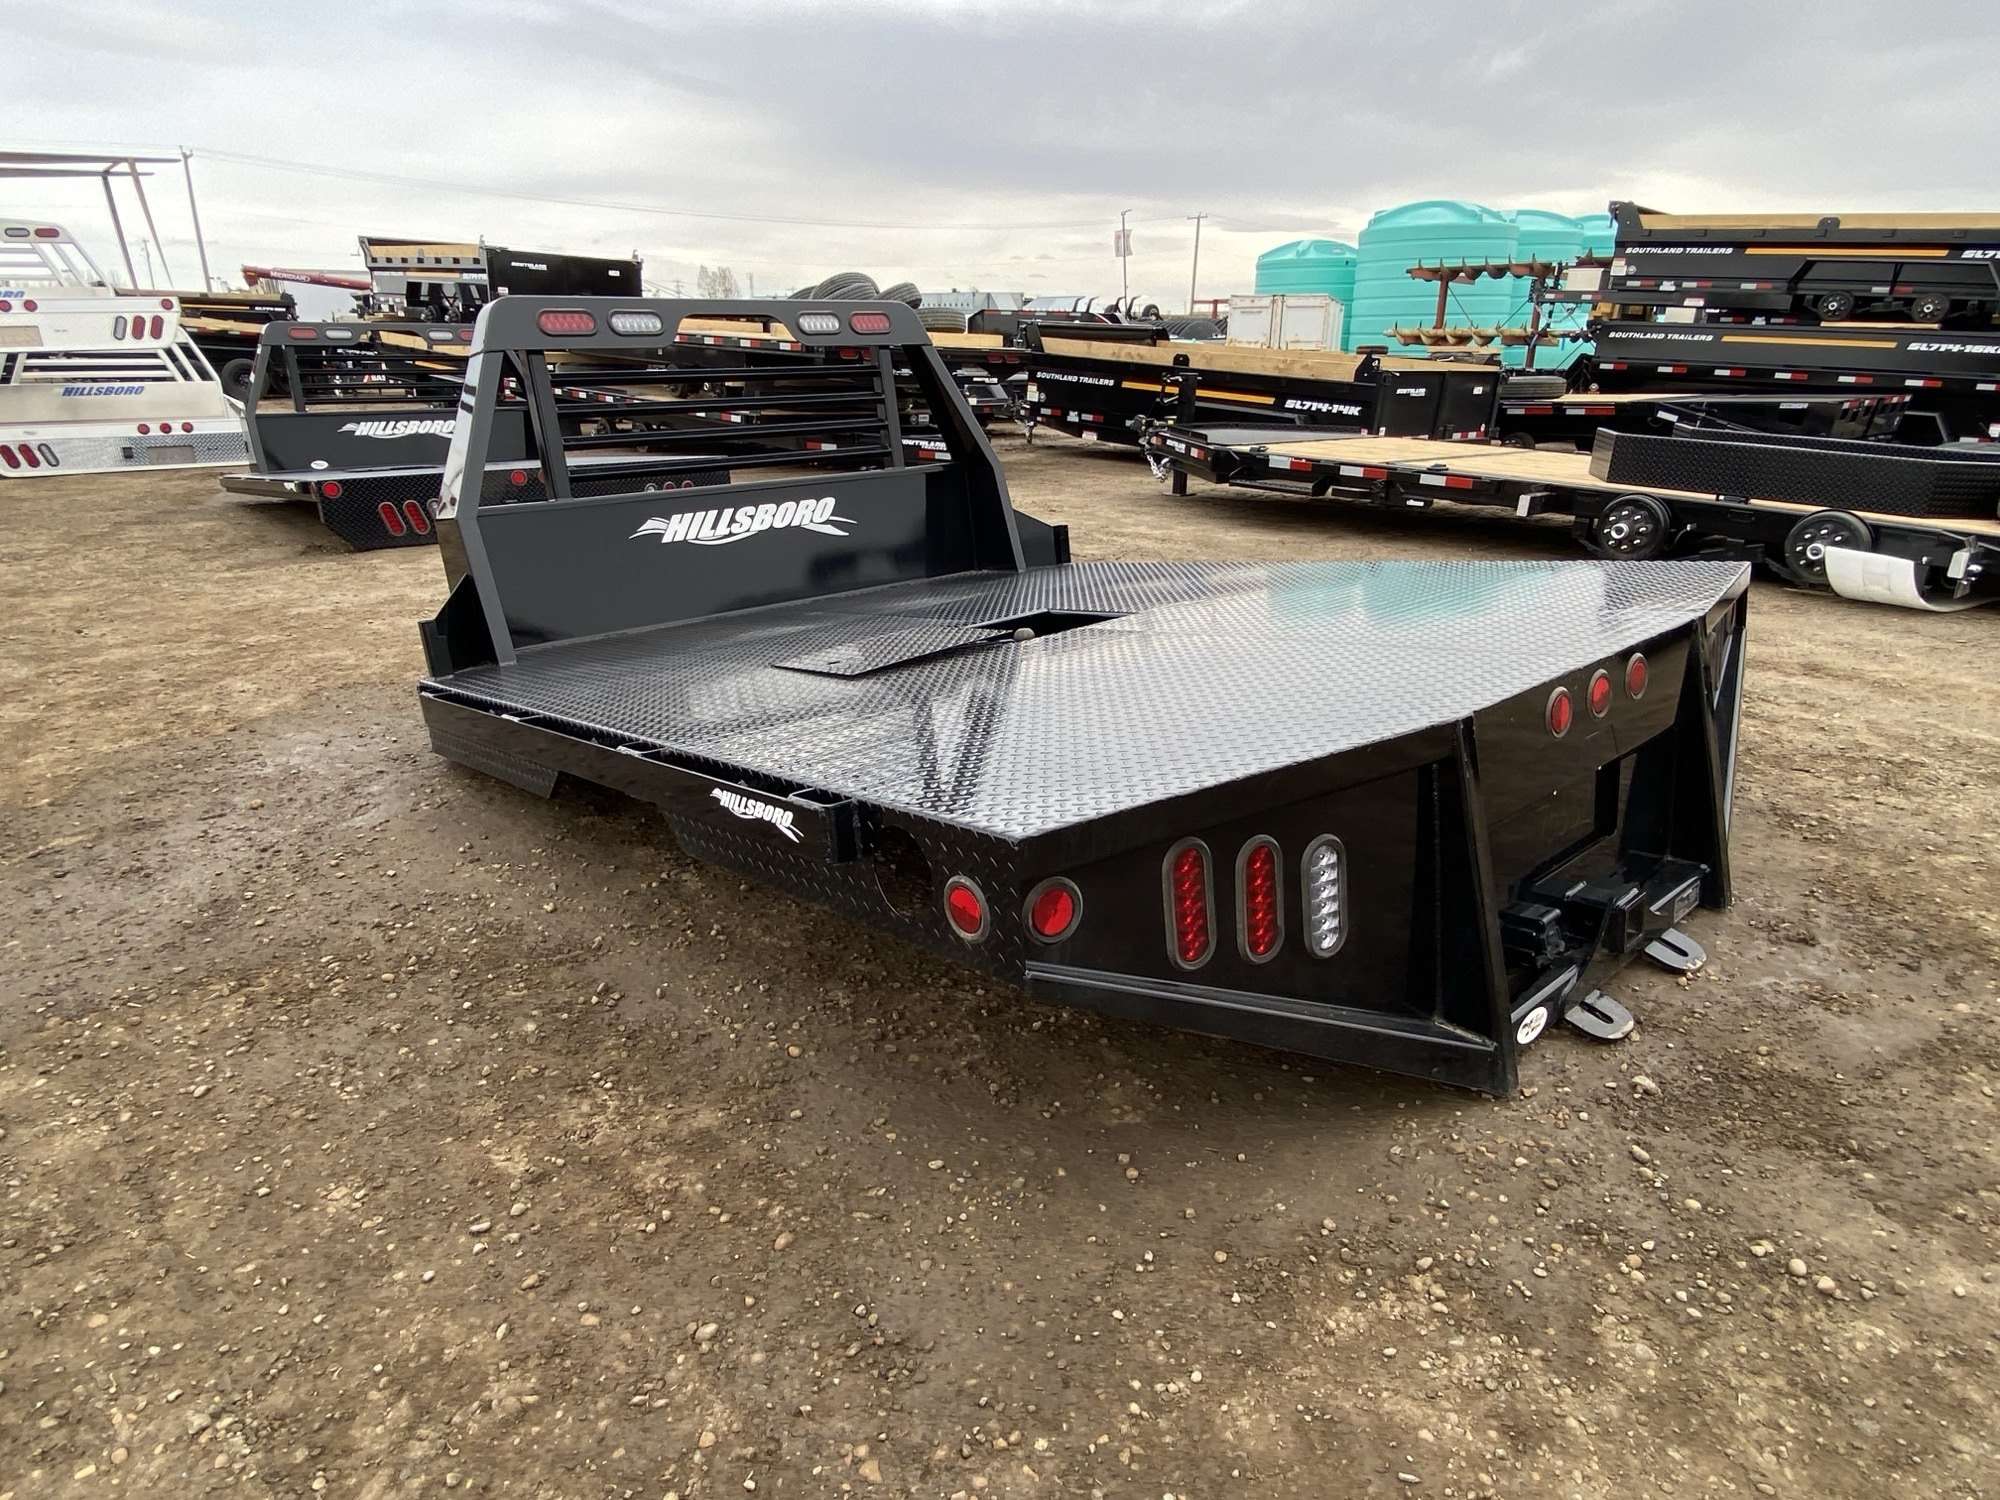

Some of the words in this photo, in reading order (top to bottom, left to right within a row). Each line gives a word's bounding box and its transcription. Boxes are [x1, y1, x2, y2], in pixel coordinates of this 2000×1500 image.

[1625, 247, 1683, 255] SOUTHLAND
[1685, 247, 1734, 255] TRAILERS
[1608, 331, 1665, 340] SOUTHLAND
[1666, 333, 1714, 342] TRAILERS
[1036, 371, 1078, 382] SOUTHLAND
[1079, 376, 1115, 387] TRAILERS
[62, 385, 145, 397] HILLSBORO
[1284, 399, 1363, 416] SL714-14K
[354, 420, 457, 436] HILLSBORO
[661, 497, 836, 544] HILLSBORO
[719, 790, 794, 828] HILLSBORO
